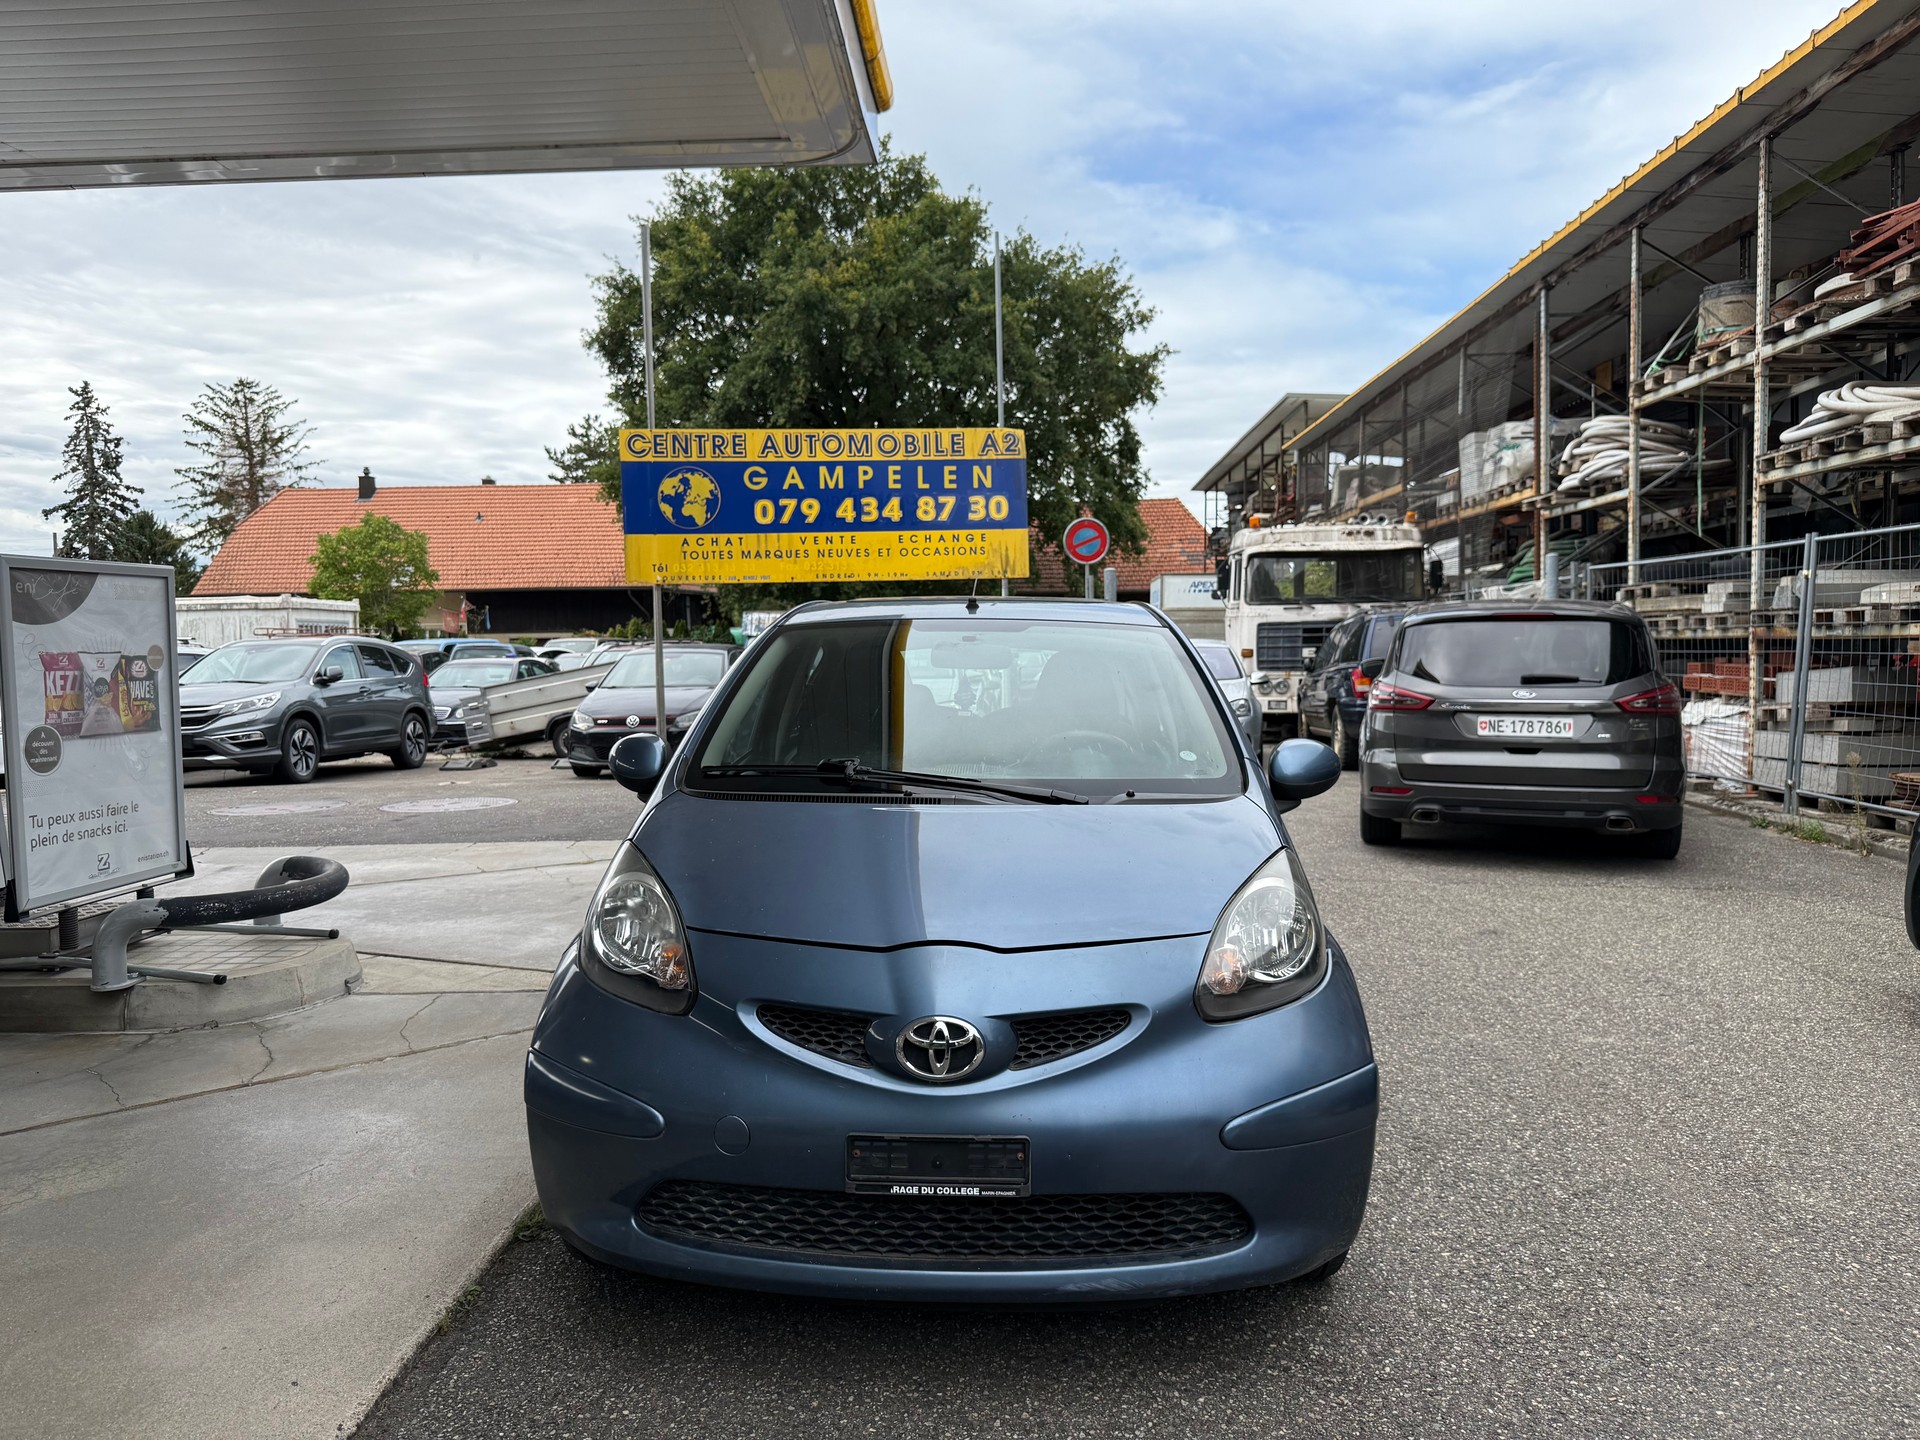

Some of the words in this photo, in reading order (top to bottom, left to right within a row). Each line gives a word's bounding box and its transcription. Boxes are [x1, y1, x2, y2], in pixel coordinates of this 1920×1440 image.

[627, 432, 747, 458] CENTRE
[758, 431, 965, 458] AUTOMOBILE
[978, 431, 1021, 456] A2
[743, 465, 992, 490] GAMPELEN
[754, 498, 821, 525] 079
[836, 496, 903, 523] 434
[916, 495, 957, 522] 87
[968, 495, 1009, 521] 30
[681, 537, 745, 548] ACHAT
[799, 535, 857, 546] VENTE
[898, 533, 987, 545] ECHANGE
[682, 549, 734, 560] TOUTES
[741, 548, 810, 560] MARQUES
[817, 547, 870, 559] NEUVES
[878, 547, 891, 557] ET
[899, 545, 986, 557] OCCASIONS
[652, 563, 669, 573] Tél
[29, 815, 44, 829] Tu
[47, 812, 76, 830] peux
[78, 805, 104, 821] aussi
[106, 802, 128, 817] faire
[131, 800, 140, 813] le
[30, 832, 59, 852] plein
[62, 830, 75, 843] de
[78, 823, 112, 840] snacks
[114, 820, 129, 834] ici.
[137, 850, 170, 863] enistation.ch
[890, 1186, 919, 1194] RAGE
[936, 1187, 980, 1196] COLLEGE
